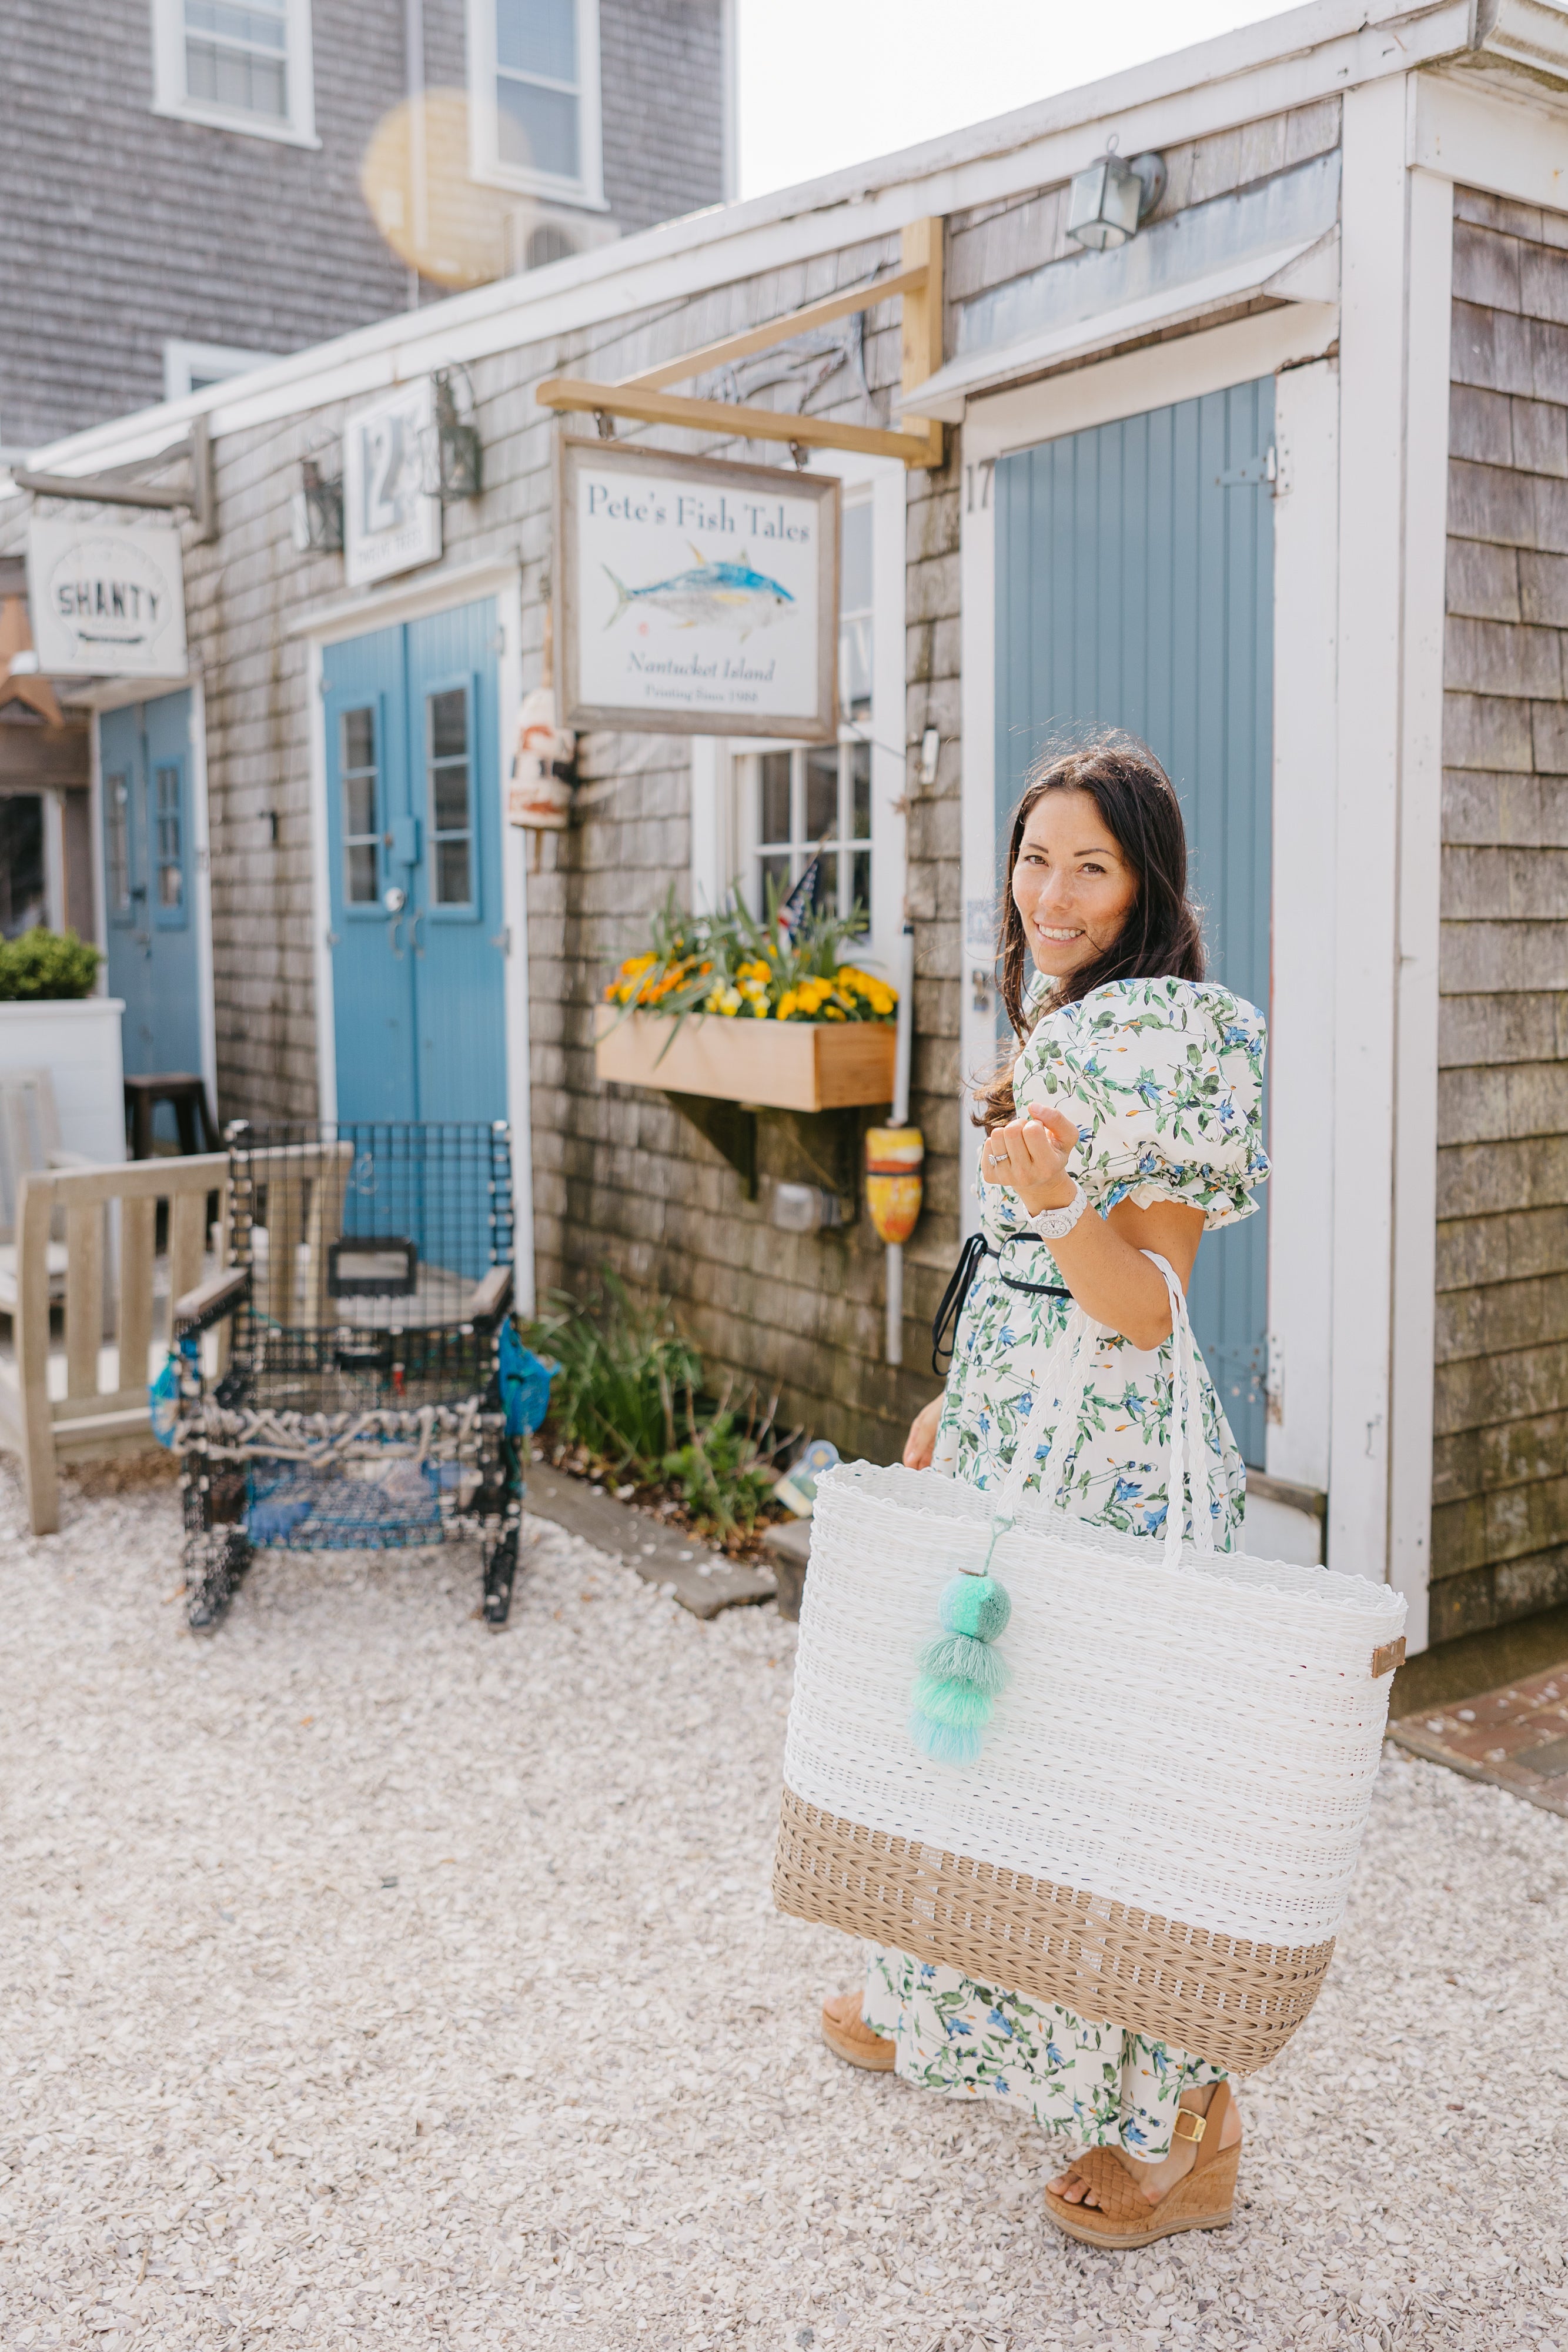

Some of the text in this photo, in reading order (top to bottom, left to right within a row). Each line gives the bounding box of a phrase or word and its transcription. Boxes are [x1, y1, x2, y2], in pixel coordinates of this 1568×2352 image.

[966, 457, 997, 513] 17
[588, 483, 810, 543] Pete's Fish Tales
[57, 578, 160, 623] SHANTY
[627, 650, 776, 683] Nantucket Island
